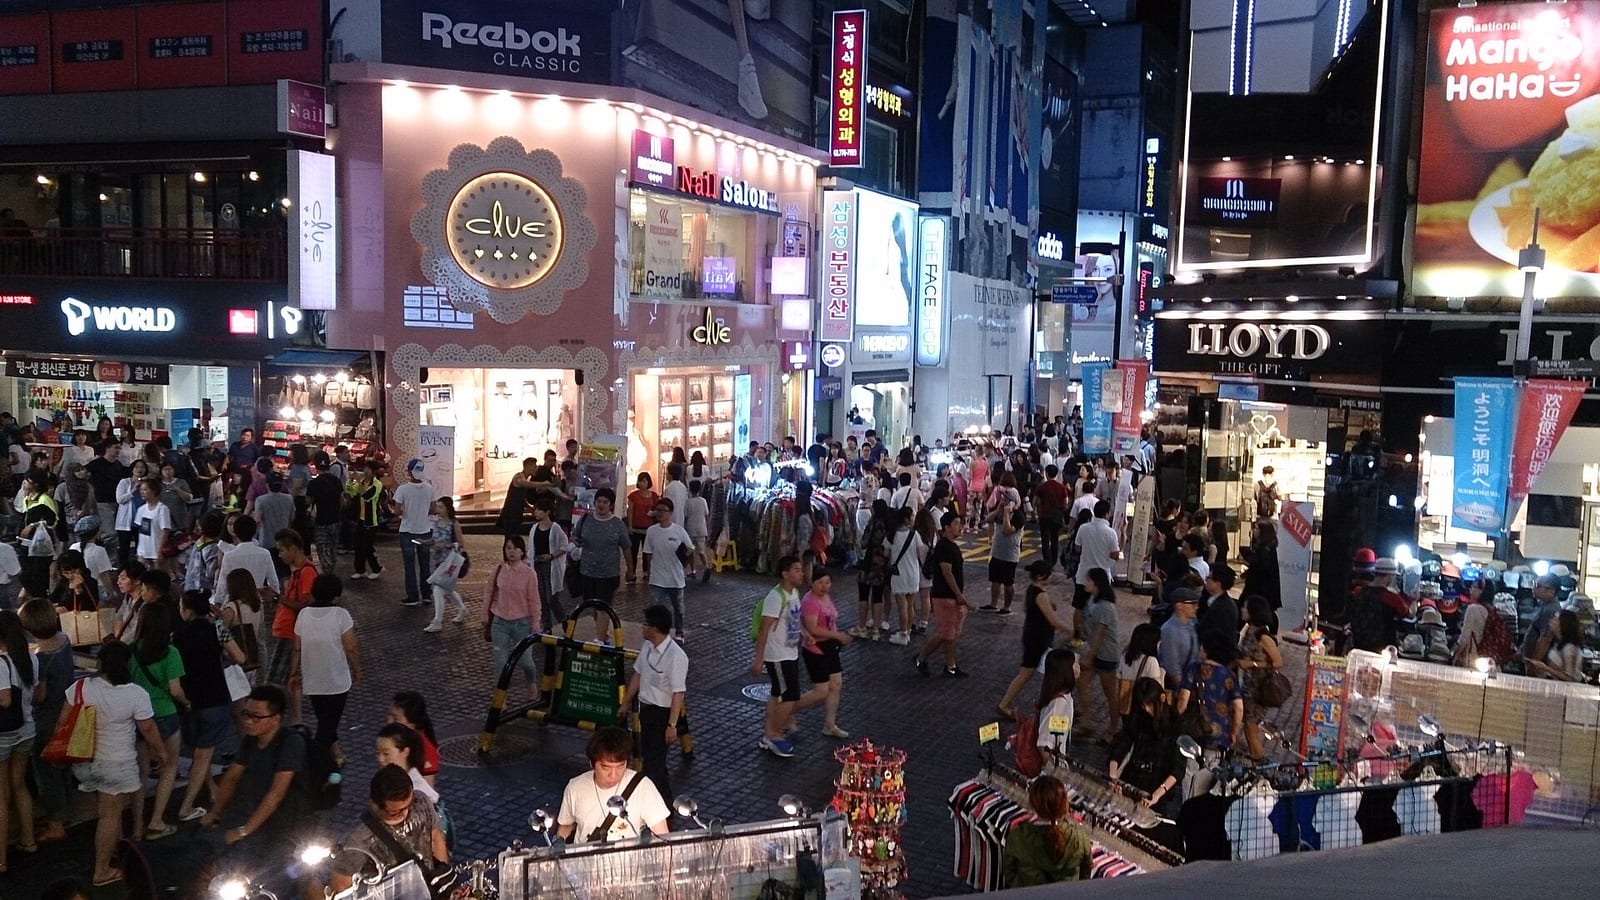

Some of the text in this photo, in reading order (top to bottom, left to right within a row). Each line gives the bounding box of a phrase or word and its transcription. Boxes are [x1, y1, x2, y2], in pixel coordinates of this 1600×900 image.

[422, 12, 580, 56] Reebok
[493, 52, 580, 73] CLASSIC
[1446, 34, 1582, 71] Mango
[1446, 72, 1545, 101] HaHa
[290, 102, 323, 122] Nail
[678, 166, 719, 199] Nail
[722, 176, 769, 210] Salon
[831, 201, 850, 249] 삼성
[1038, 232, 1063, 260] adidas
[646, 270, 681, 290] Grand
[828, 250, 849, 321] 부동산
[93, 306, 176, 332] WORLD
[1186, 323, 1331, 360] LLOYD
[68, 363, 90, 378] 보장!
[135, 366, 157, 381] 출시!
[1219, 361, 1281, 375] THE GIFT
[420, 436, 452, 446] EVENT
[1286, 513, 1310, 541] SALE
